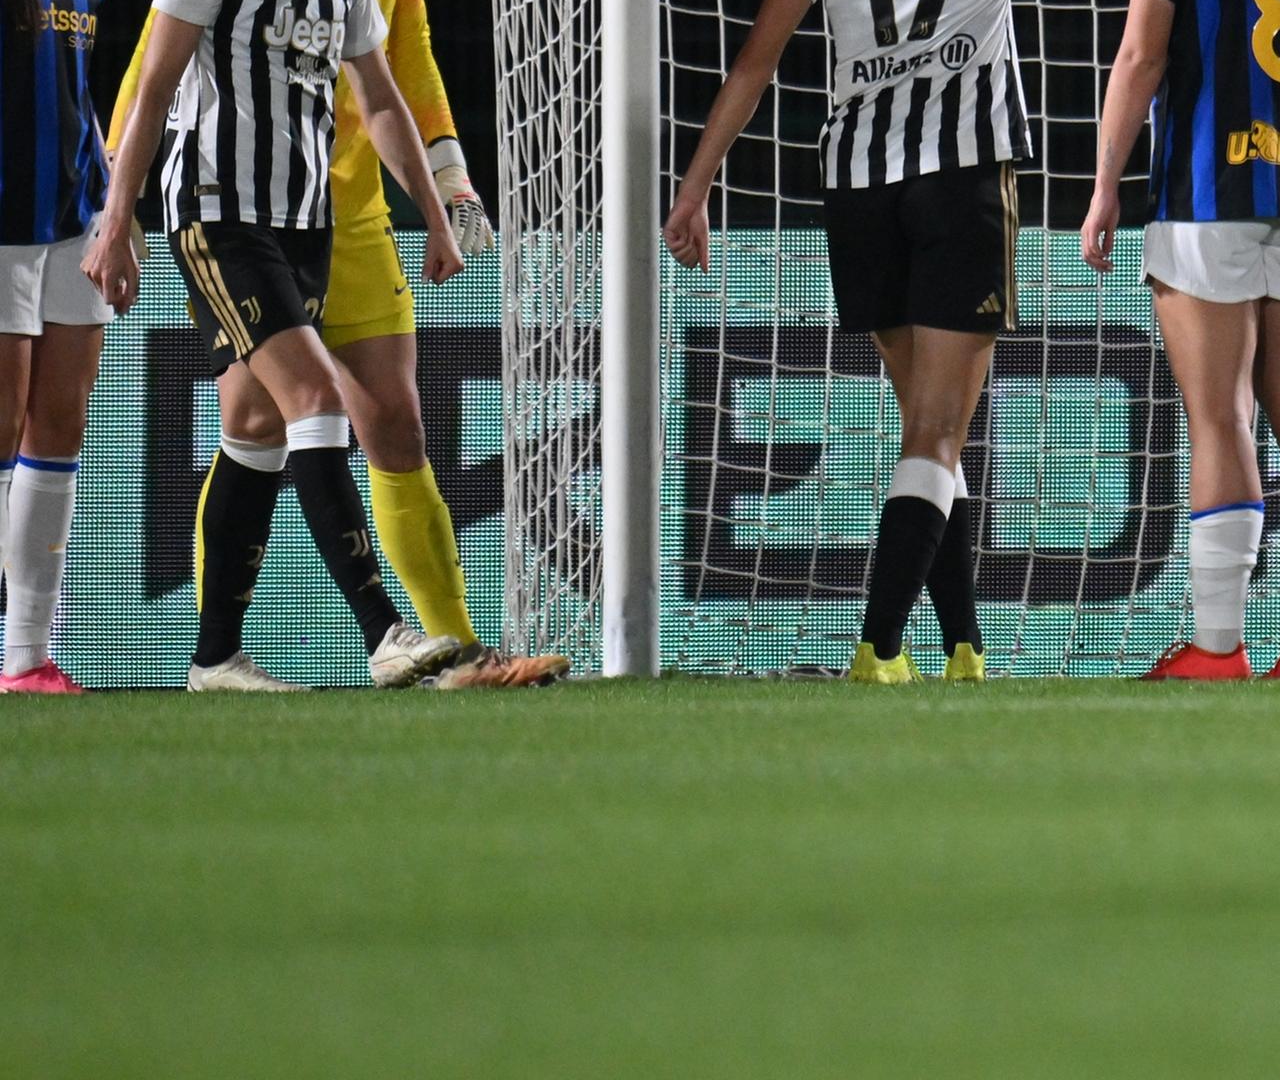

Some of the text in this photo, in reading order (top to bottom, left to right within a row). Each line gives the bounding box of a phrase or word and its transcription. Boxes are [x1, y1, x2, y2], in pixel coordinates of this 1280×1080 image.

[40, 2, 97, 36] etsson
[264, 7, 346, 61] Jeep
[851, 50, 933, 84] Allianz
